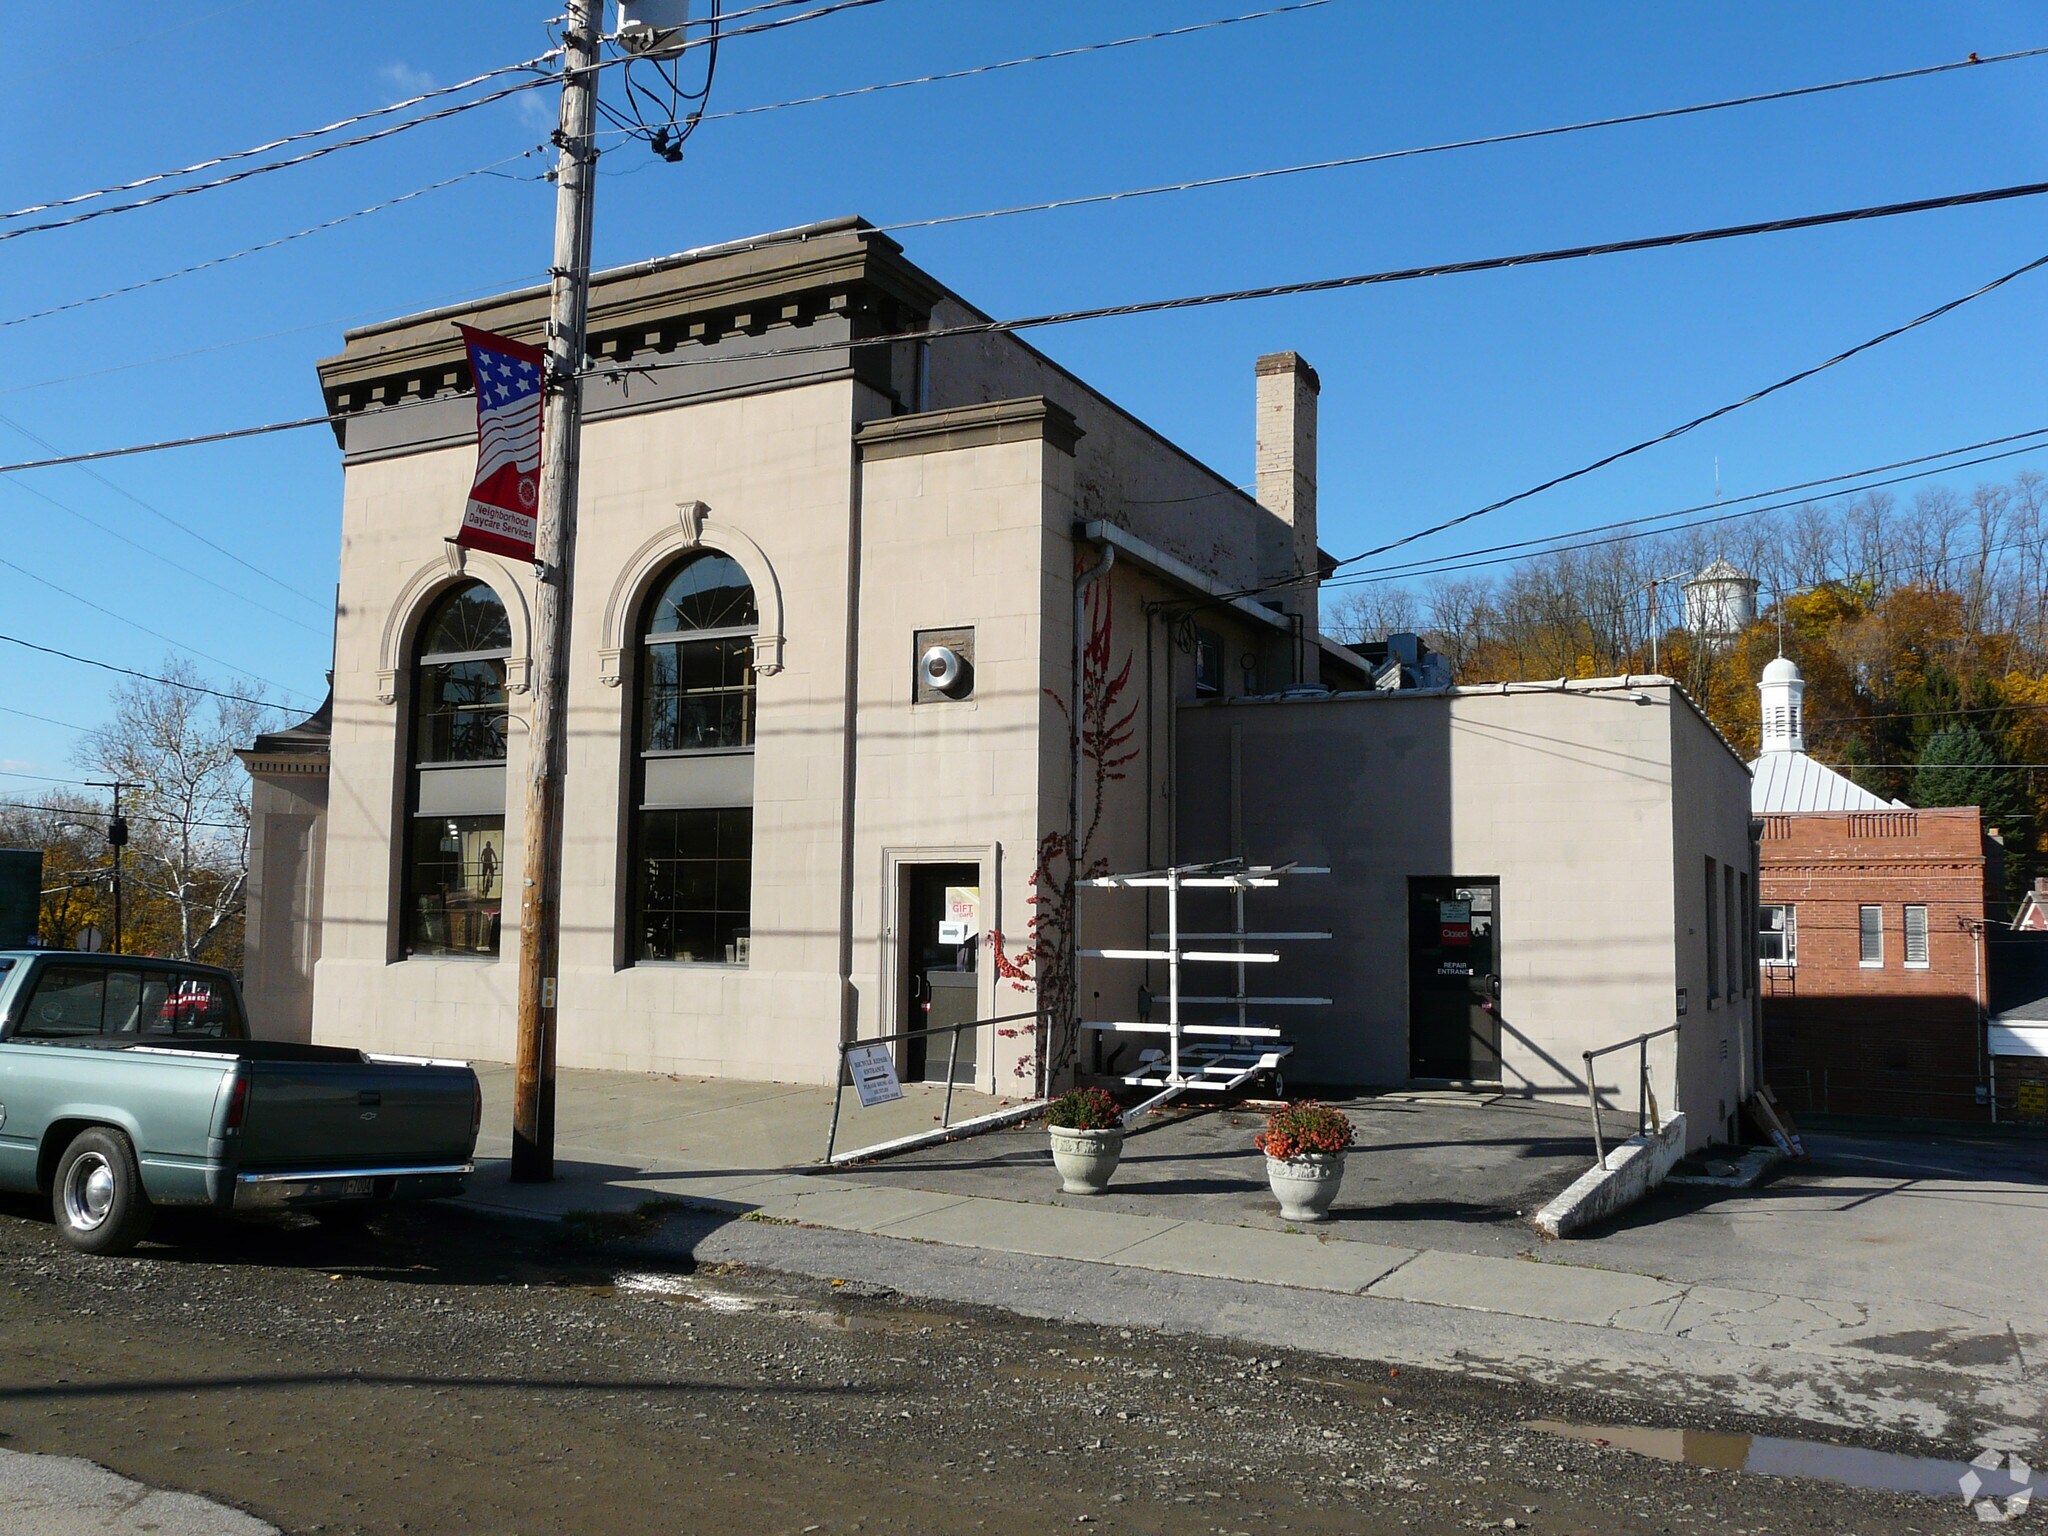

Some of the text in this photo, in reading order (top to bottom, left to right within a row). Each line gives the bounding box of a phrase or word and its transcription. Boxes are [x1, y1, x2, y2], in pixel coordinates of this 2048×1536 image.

[475, 504, 529, 527] Neighborhood
[469, 512, 533, 539] Daycare Services
[1442, 929, 1468, 937] Closed
[1437, 968, 1474, 976] ENTRANCE
